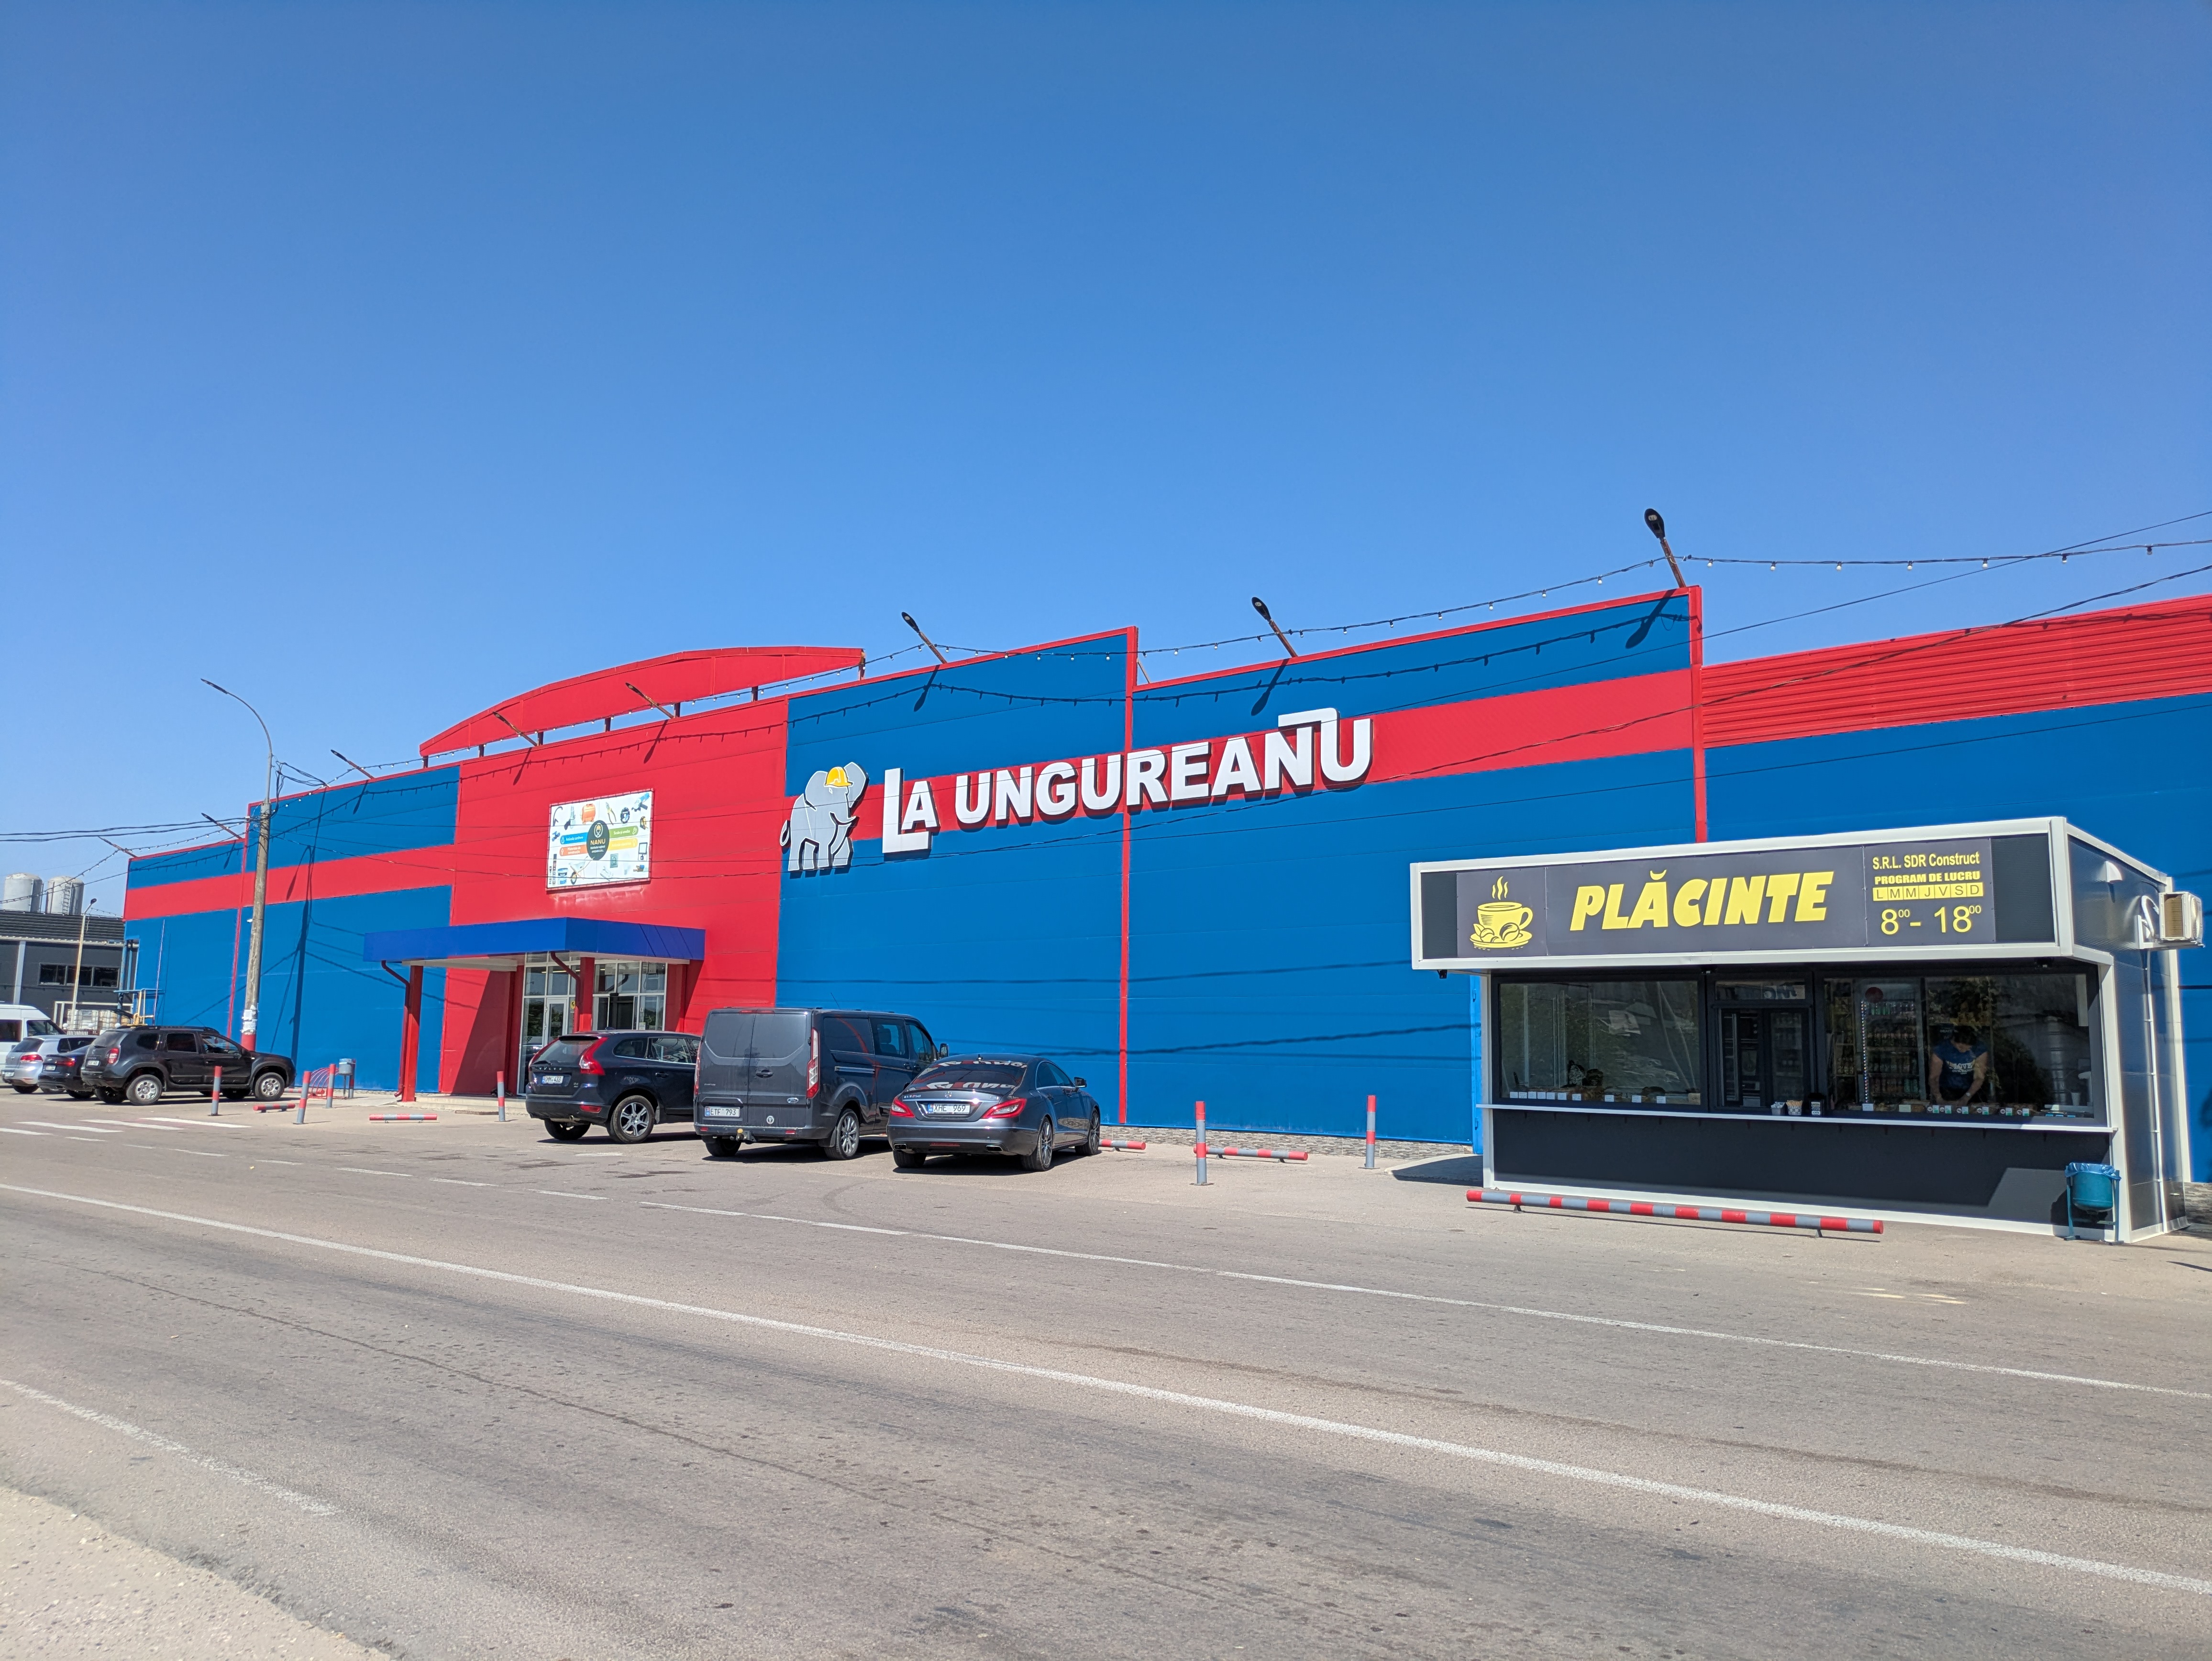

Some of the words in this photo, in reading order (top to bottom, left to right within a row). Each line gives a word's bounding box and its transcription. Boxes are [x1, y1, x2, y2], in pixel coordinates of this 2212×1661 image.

[882, 767, 938, 853] LA
[955, 708, 1373, 824] UNGUREANU
[1872, 856, 1901, 870] S.R.L.
[1904, 854, 1926, 868] SDR
[1929, 851, 1980, 866] Construct
[1874, 874, 1926, 885] PROGRAM
[1929, 873, 1942, 882] DE
[1944, 871, 1980, 881] LUCRU
[1570, 869, 1834, 931] PLĂCINTE
